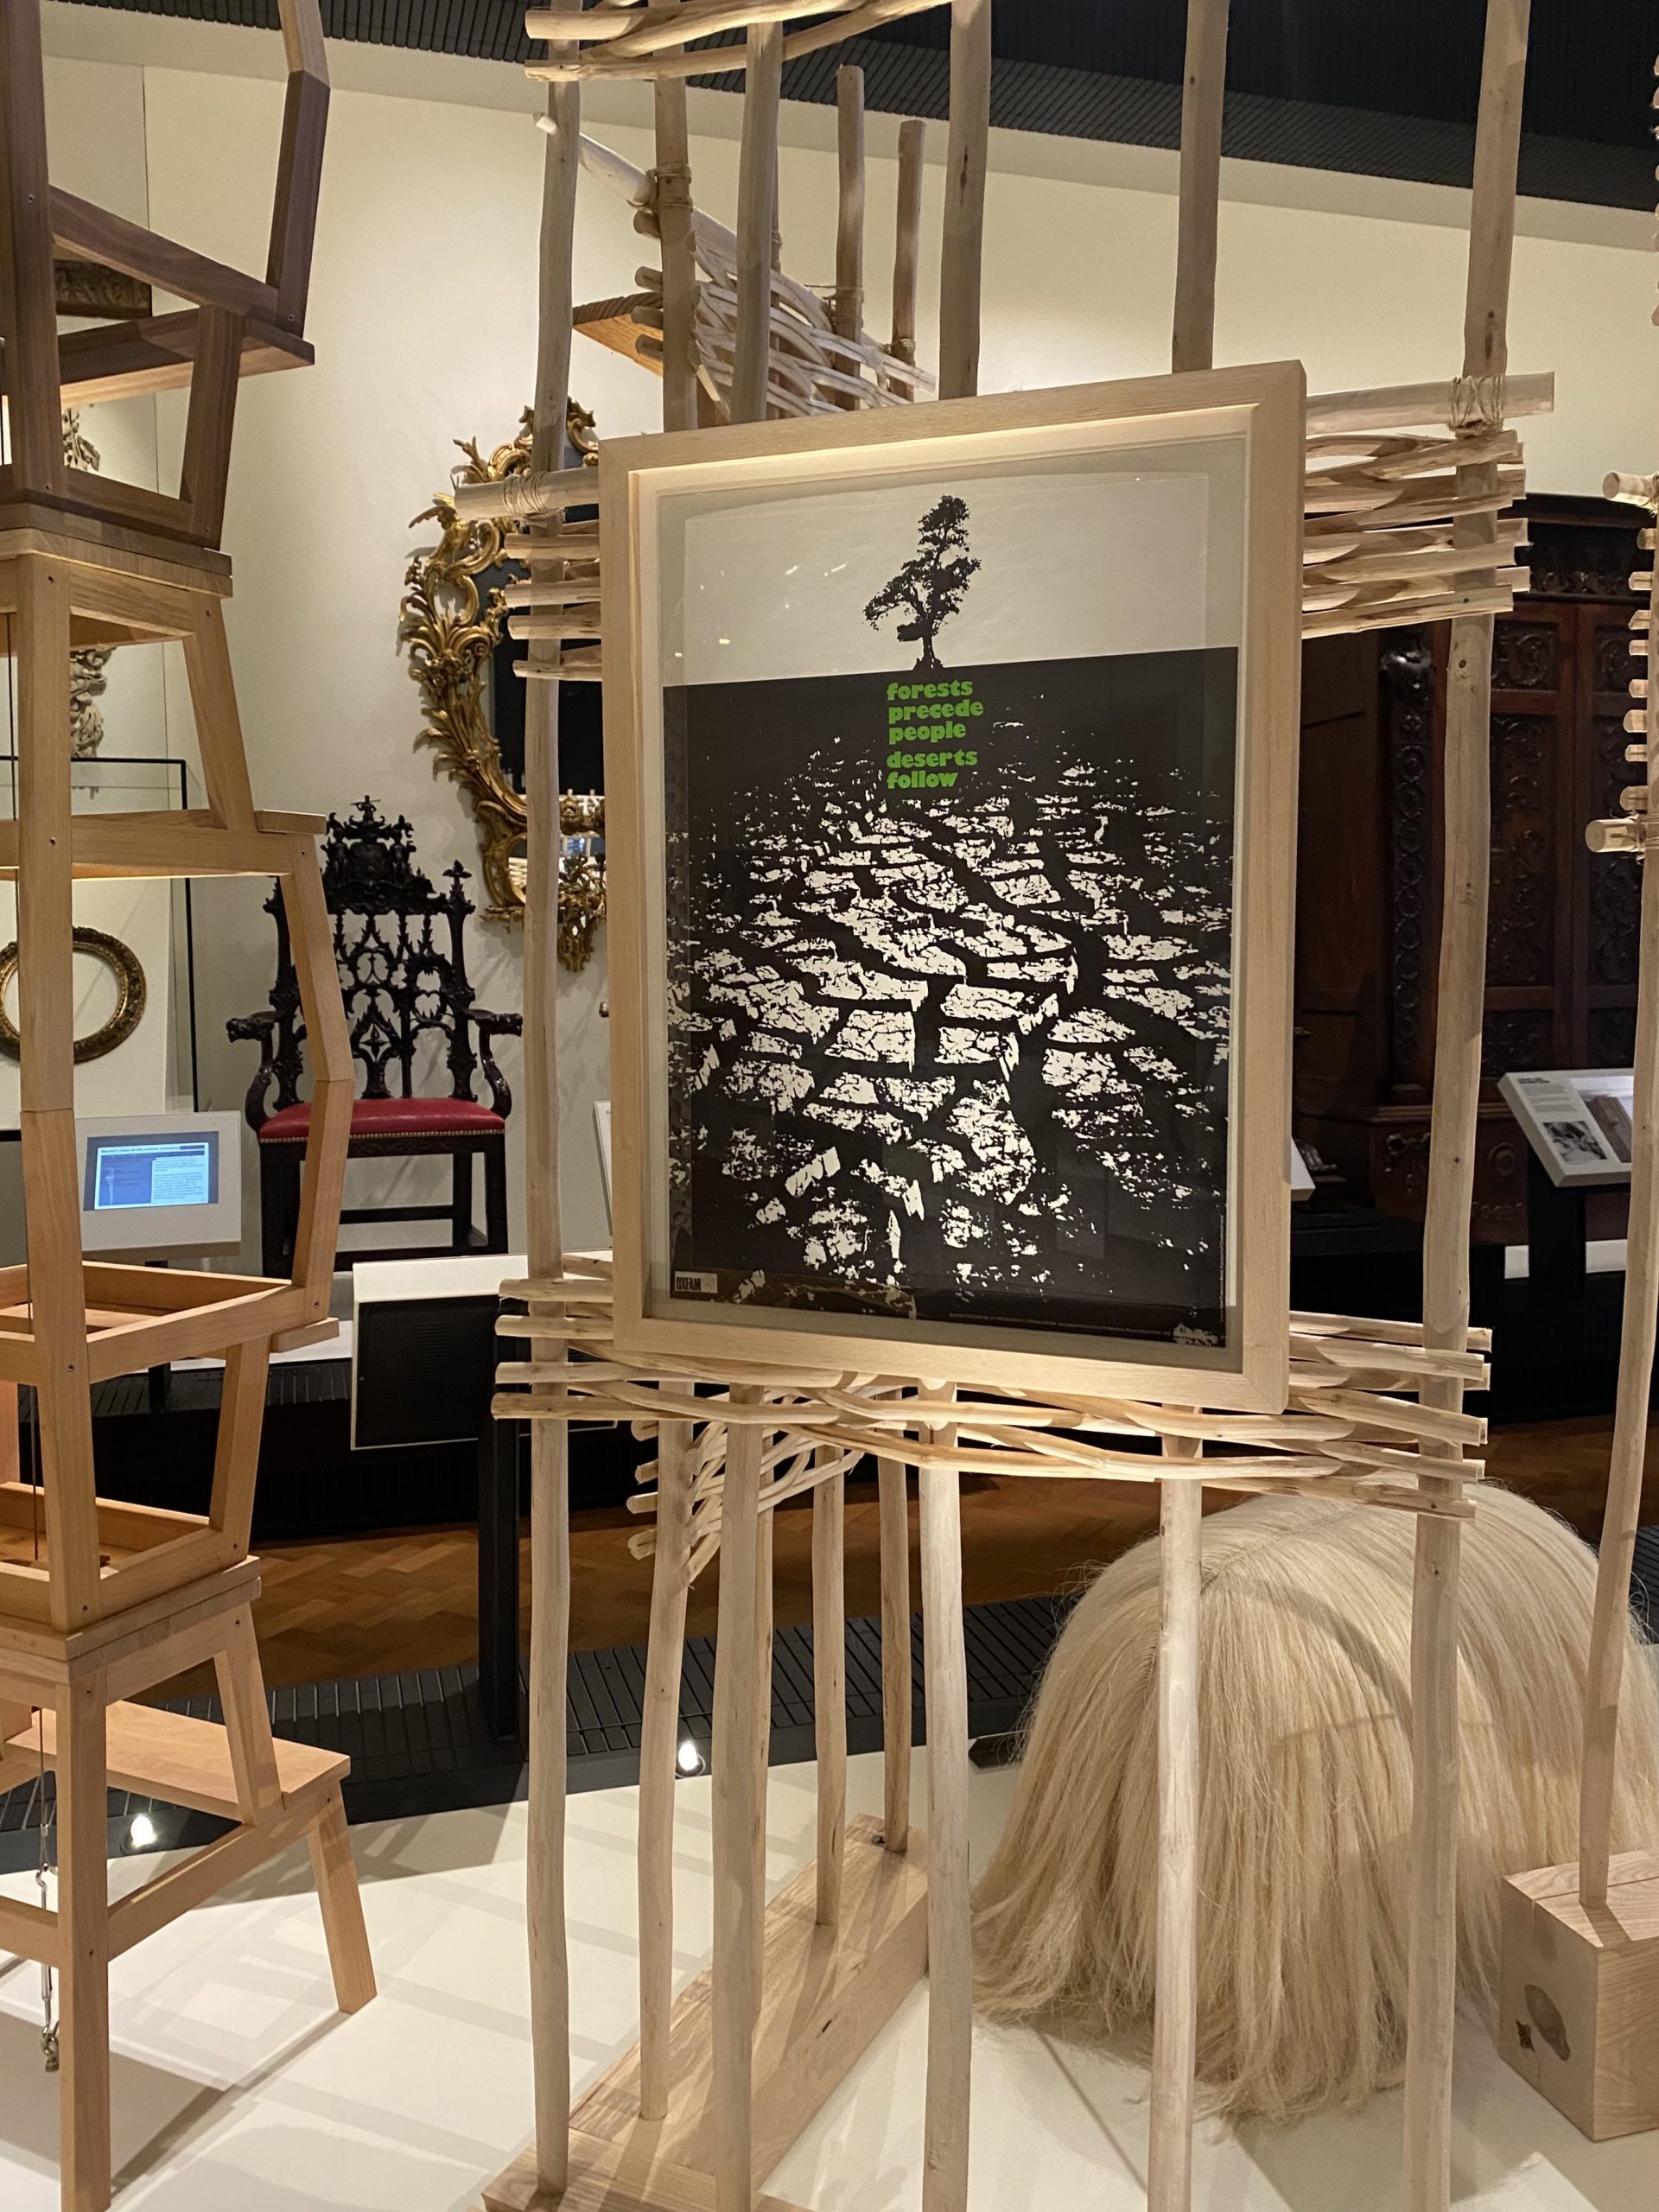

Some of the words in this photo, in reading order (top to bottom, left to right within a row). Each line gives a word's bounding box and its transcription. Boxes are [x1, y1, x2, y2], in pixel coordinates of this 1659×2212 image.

[887, 680, 973, 701] forests
[888, 698, 982, 725] precede
[888, 720, 966, 746] people
[886, 749, 978, 769] deserts
[887, 770, 958, 790] follow
[676, 1276, 702, 1291] OXFAM
